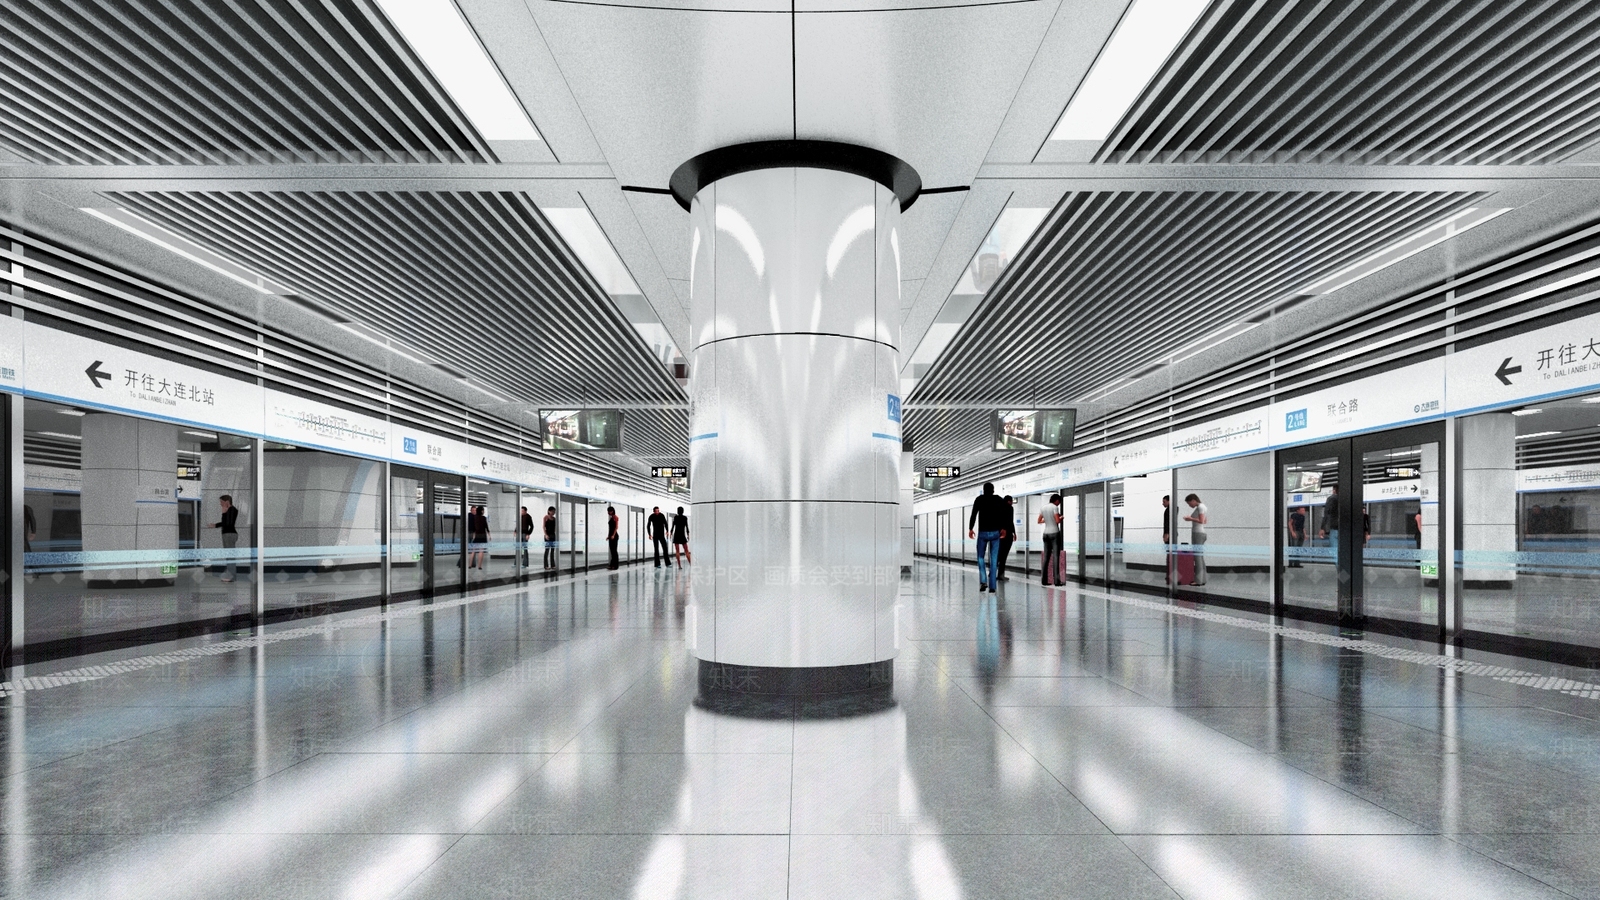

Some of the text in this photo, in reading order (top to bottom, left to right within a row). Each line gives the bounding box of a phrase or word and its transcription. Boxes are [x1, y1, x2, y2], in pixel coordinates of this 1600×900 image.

[1543, 372, 1552, 380] To
[124, 369, 215, 406] 开往大连北站
[130, 390, 177, 406] To DALIANBEIZHAN
[1327, 398, 1359, 417] 联合路
[1287, 414, 1294, 429] 2
